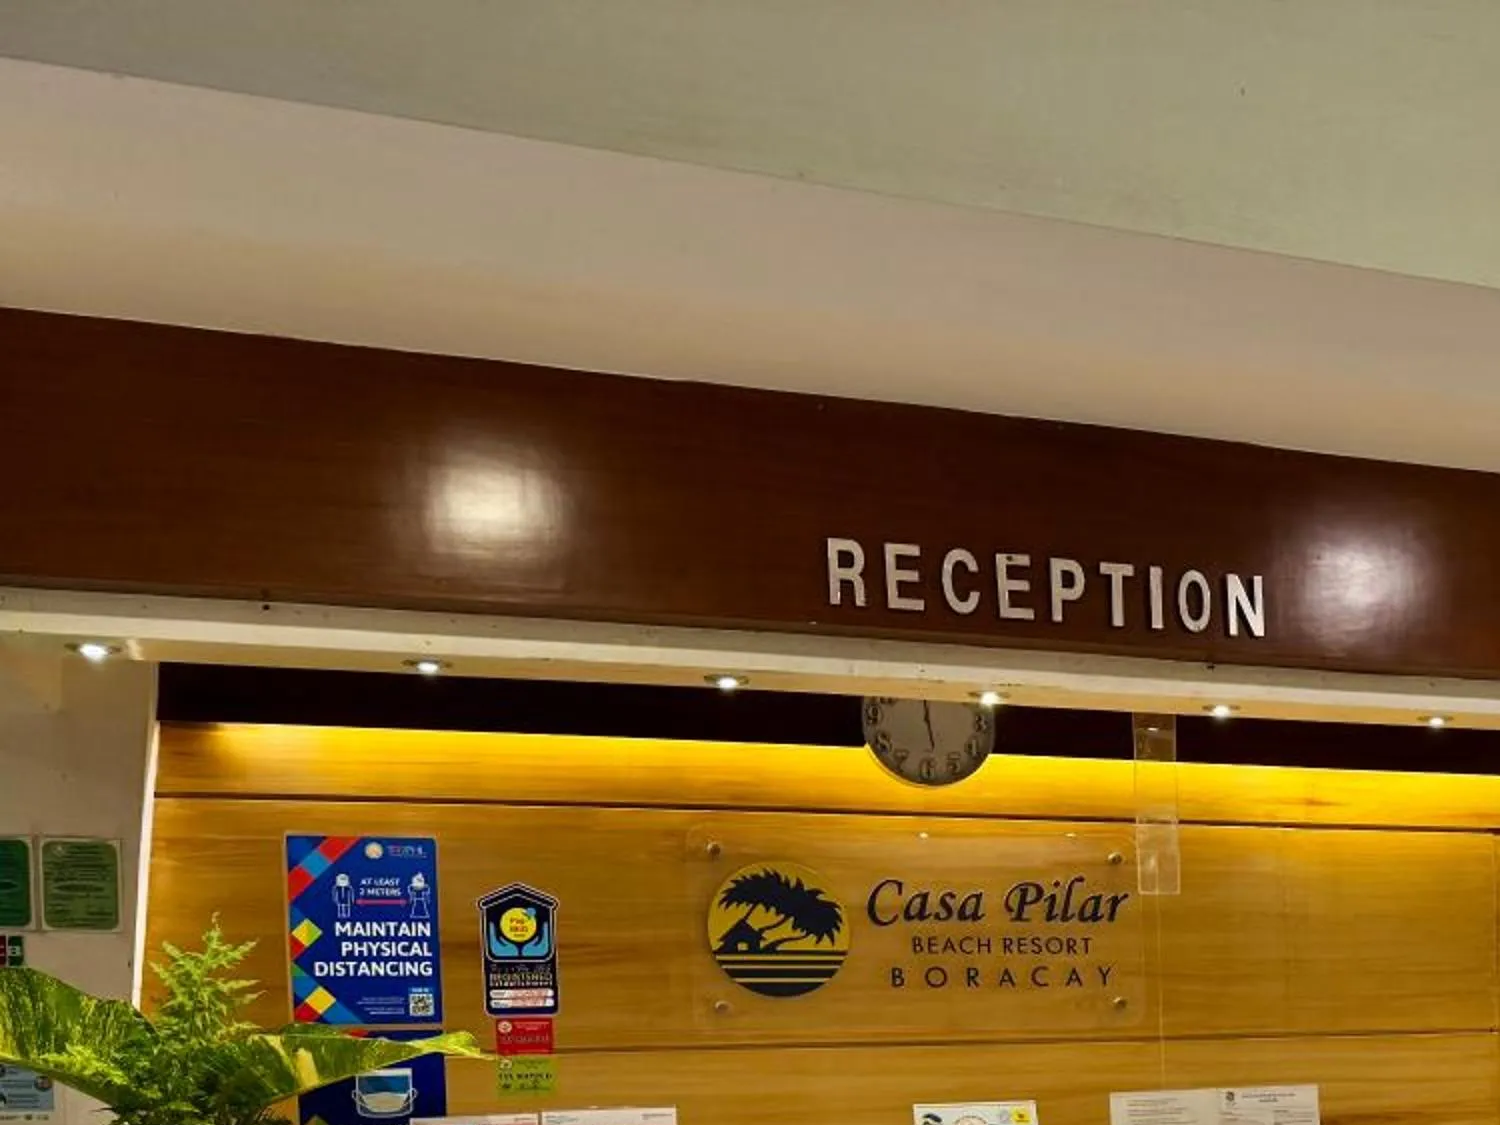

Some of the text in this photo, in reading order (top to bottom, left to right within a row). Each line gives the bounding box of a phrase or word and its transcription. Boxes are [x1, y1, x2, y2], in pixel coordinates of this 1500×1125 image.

[827, 537, 1265, 638] RECEPTION
[360, 878, 400, 886] AT LEAST
[367, 887, 401, 896] METERS
[866, 875, 1129, 927] Casa Pilar
[334, 921, 431, 937] MAINTAIN
[341, 941, 432, 957] PHYSICAL
[911, 936, 1093, 955] BEACH RESORT
[314, 961, 433, 977] DISTANCING
[890, 966, 1115, 989] BORACAY
